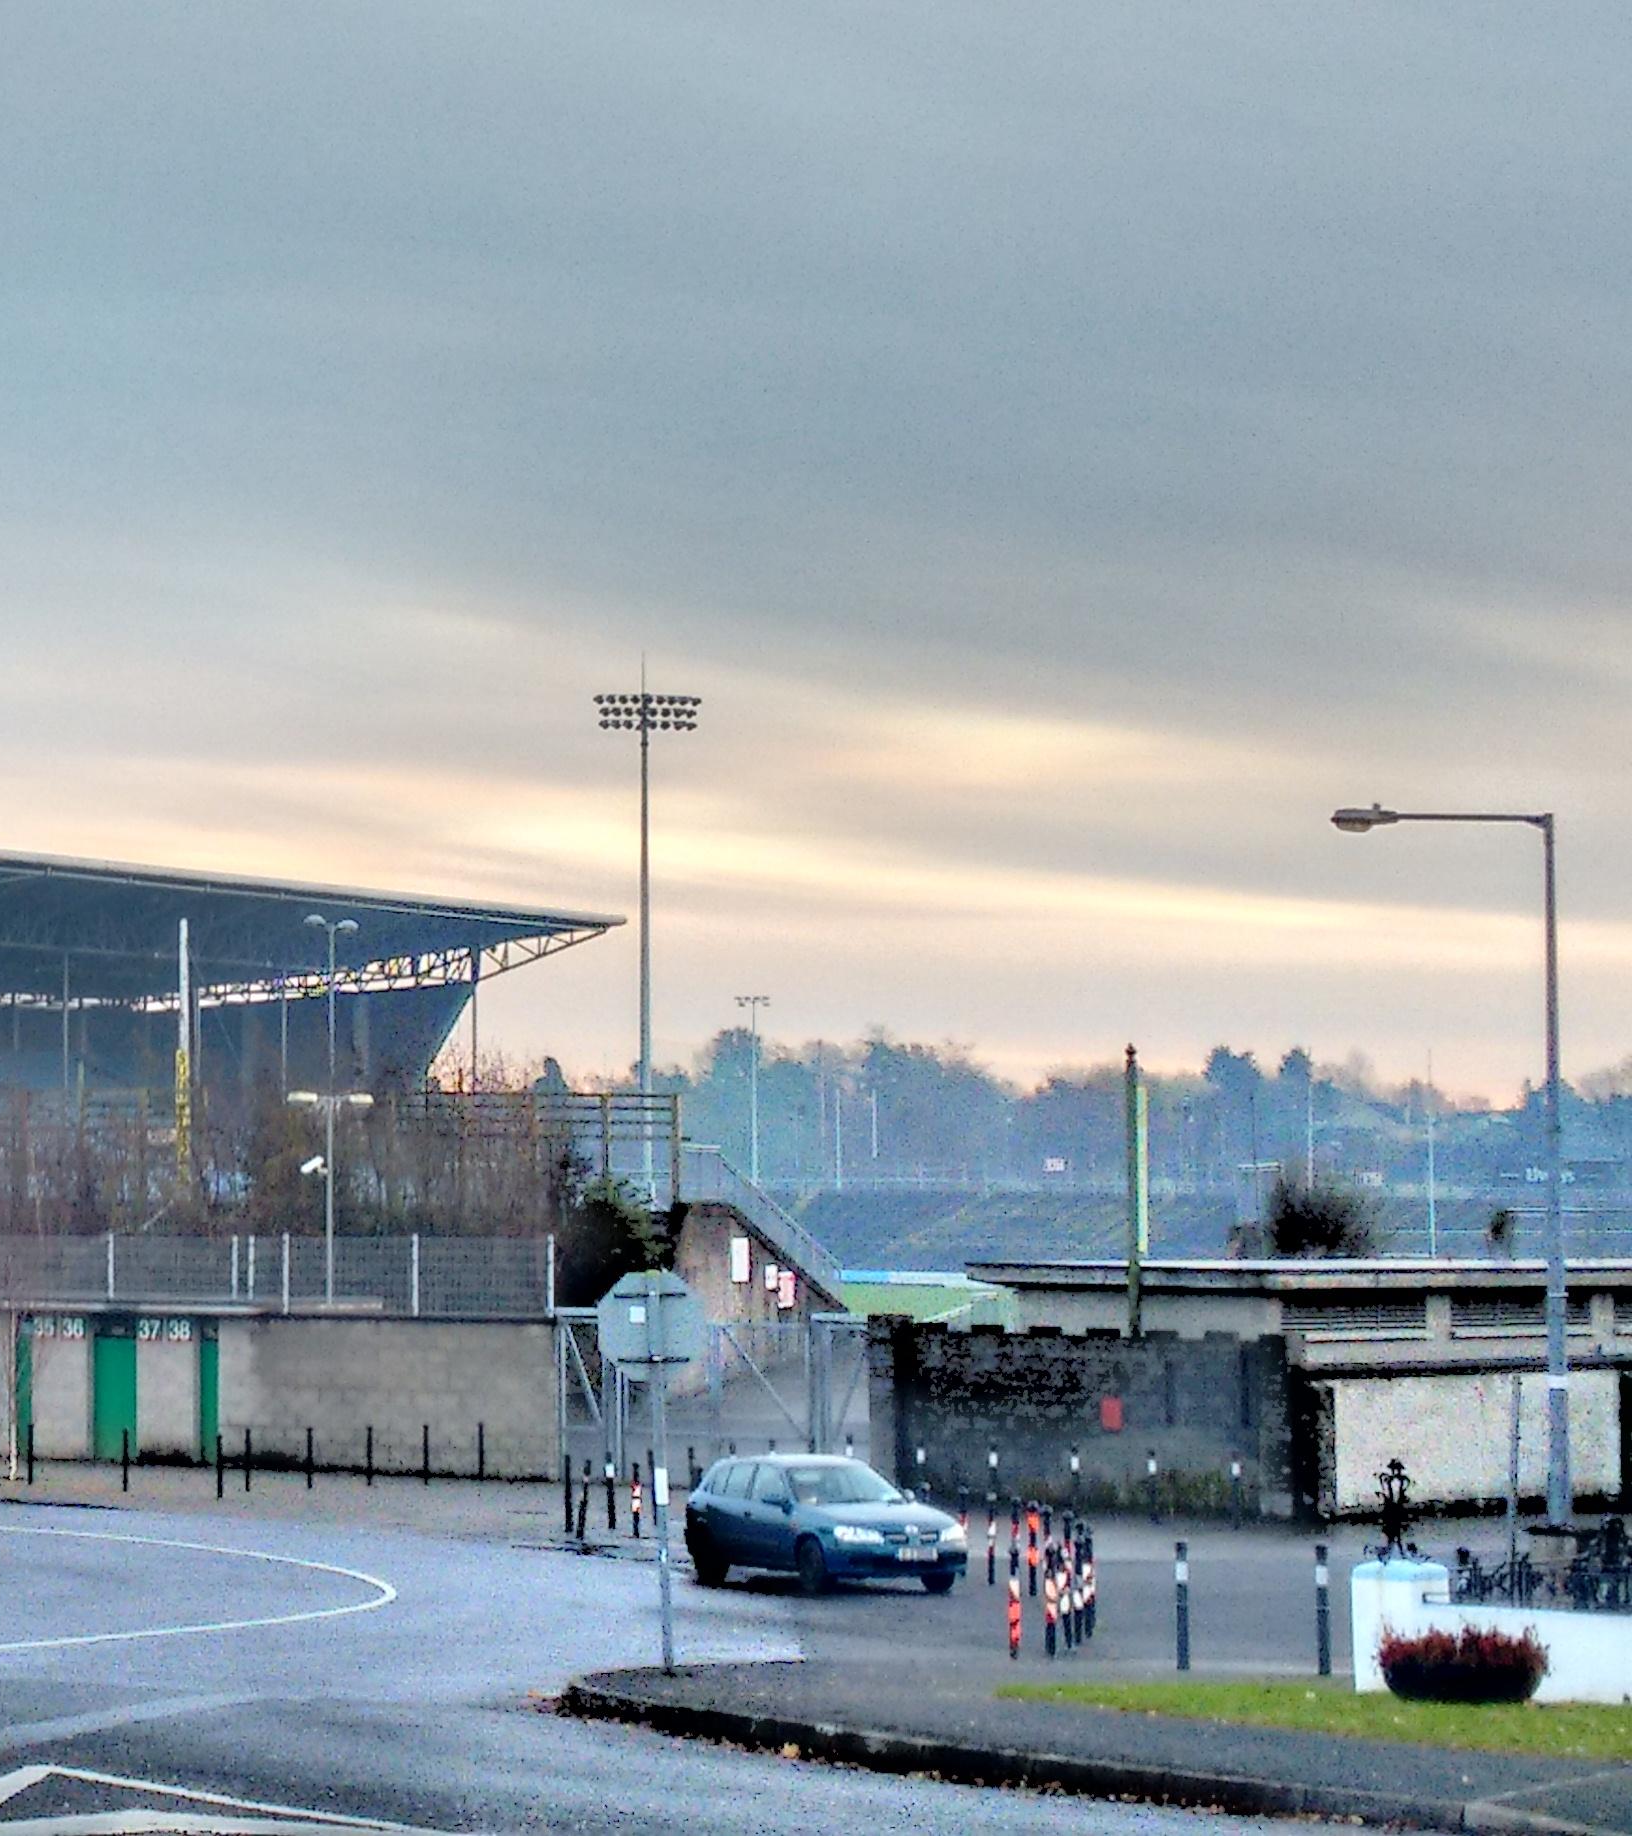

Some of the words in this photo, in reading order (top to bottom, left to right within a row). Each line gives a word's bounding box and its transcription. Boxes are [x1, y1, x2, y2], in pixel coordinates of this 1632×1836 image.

[62, 1316, 84, 1337] 36
[139, 1318, 161, 1339] 37
[169, 1320, 191, 1341] 38
